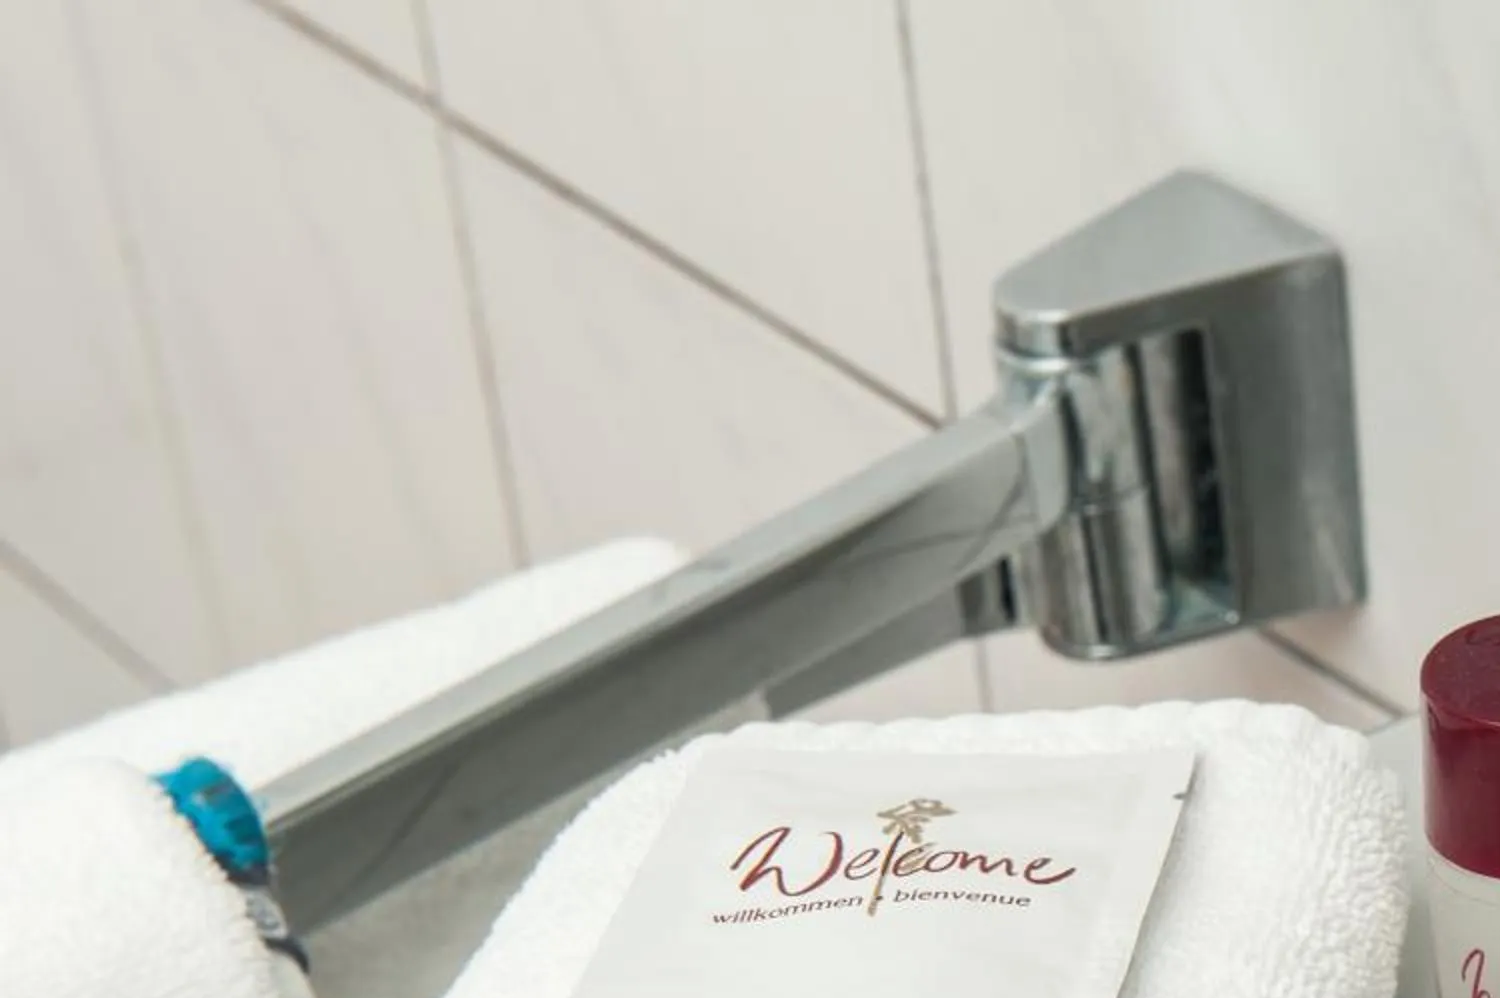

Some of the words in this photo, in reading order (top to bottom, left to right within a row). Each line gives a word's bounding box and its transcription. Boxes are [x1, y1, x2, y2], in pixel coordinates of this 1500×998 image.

[730, 826, 1076, 897] Welcome
[711, 895, 863, 924] willkommen
[893, 889, 1032, 907] bienvenue
